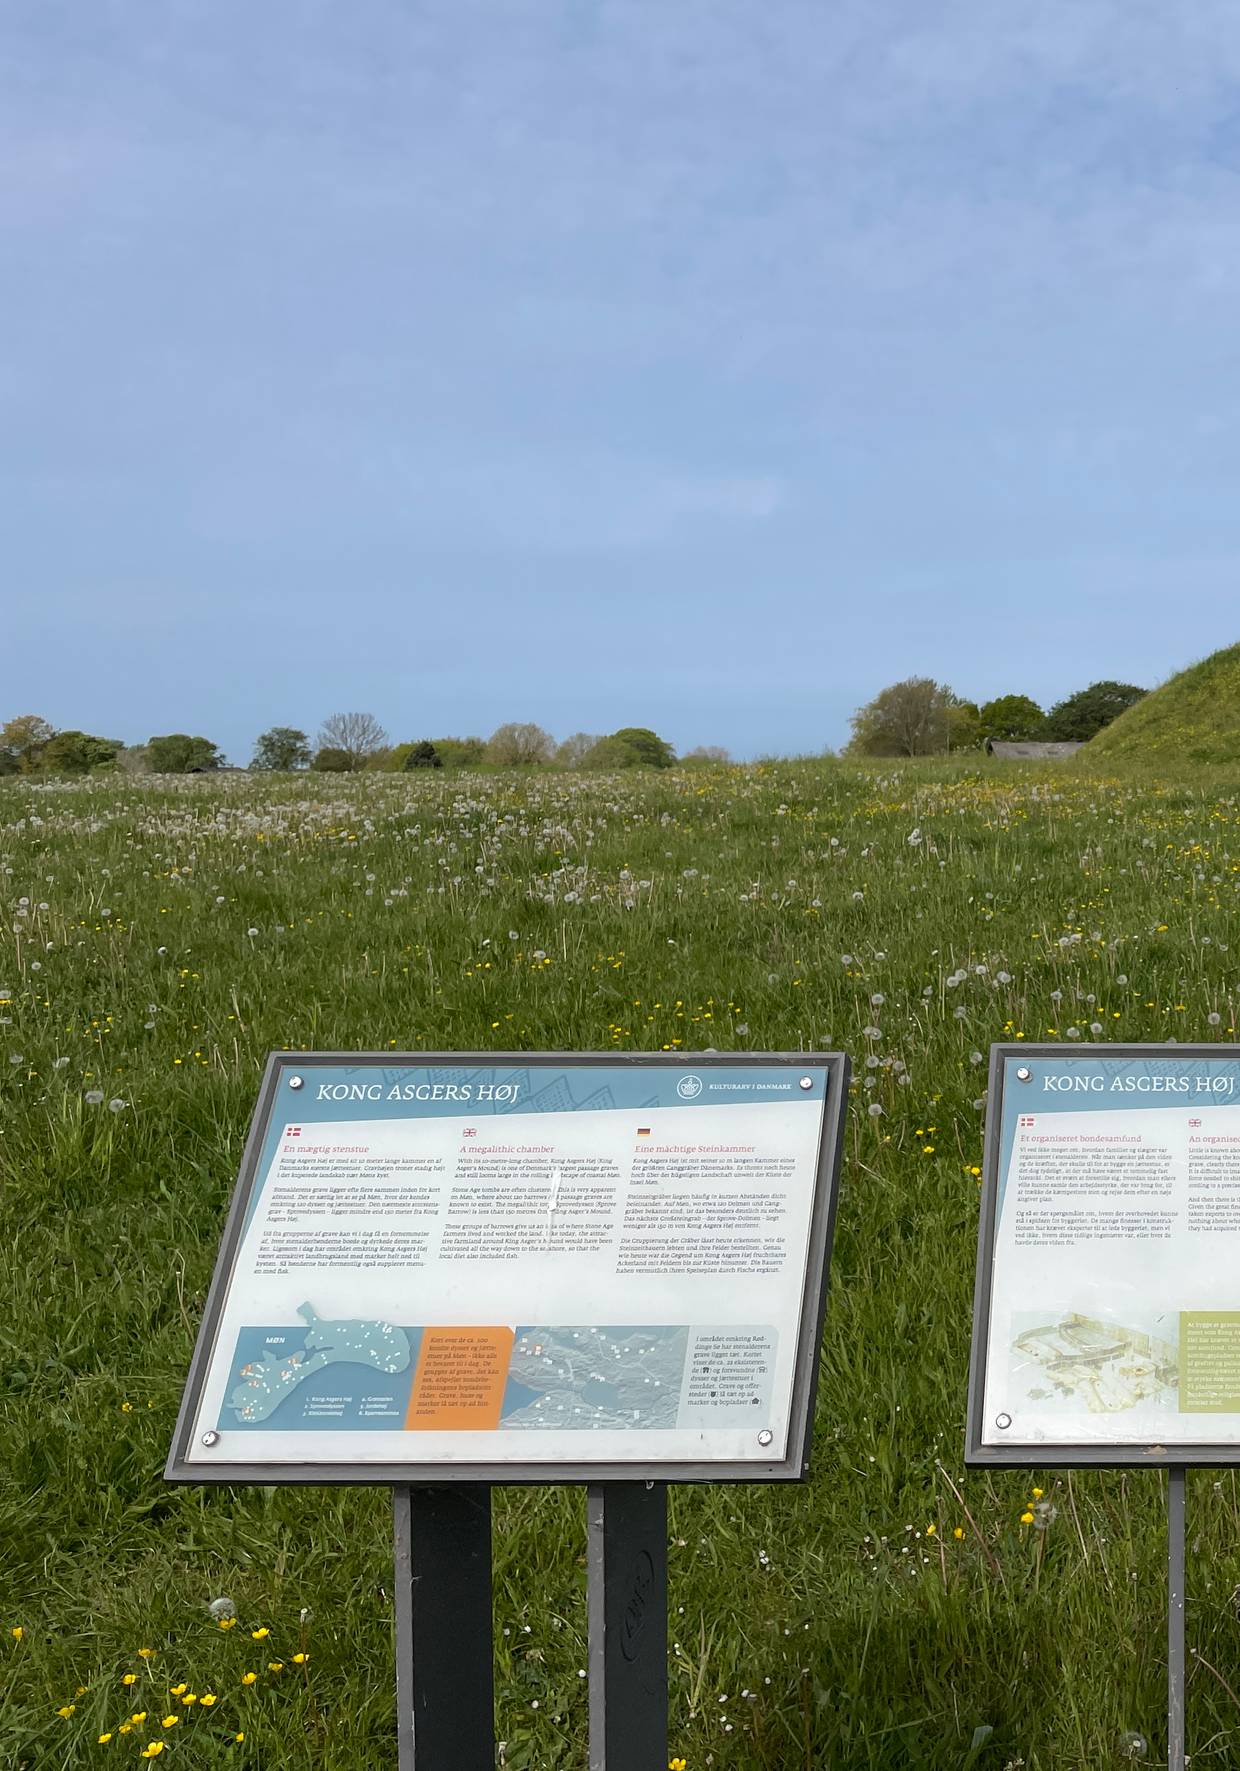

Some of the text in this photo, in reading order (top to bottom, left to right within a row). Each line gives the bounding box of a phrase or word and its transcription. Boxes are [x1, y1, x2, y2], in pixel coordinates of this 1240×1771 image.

[1043, 1076, 1234, 1094] KONG ASGERS HØJ
[316, 1084, 520, 1104] KONG ASGERS HØJ
[1032, 1135, 1078, 1143] organiseret
[468, 1146, 513, 1154] megalithic
[656, 1146, 696, 1154] mächtige
